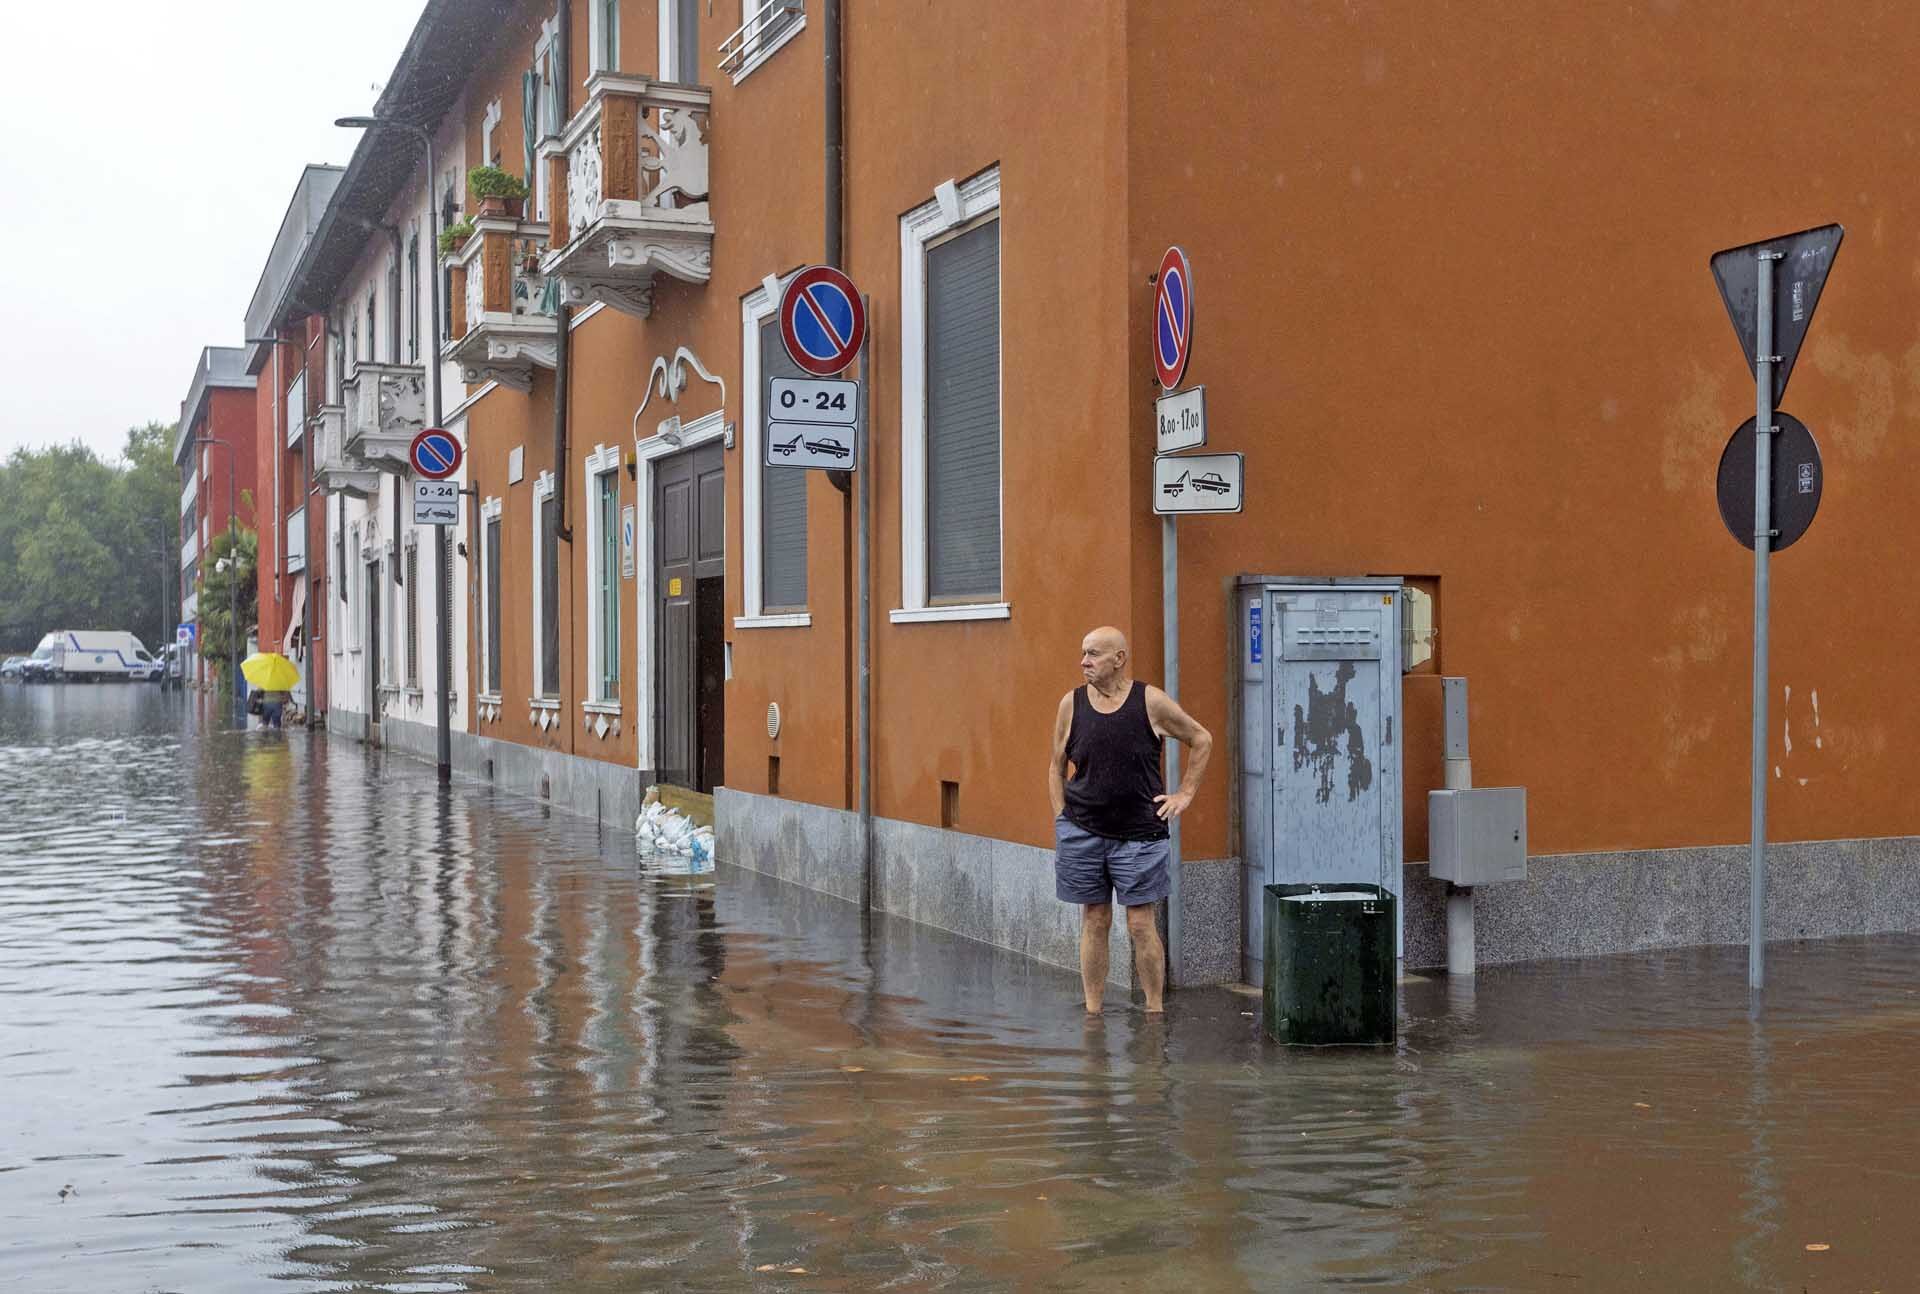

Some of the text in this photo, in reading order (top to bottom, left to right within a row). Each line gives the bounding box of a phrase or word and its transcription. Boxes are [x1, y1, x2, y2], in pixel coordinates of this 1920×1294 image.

[781, 390, 796, 408] 0
[815, 392, 847, 411] 24
[438, 487, 453, 496] 24
